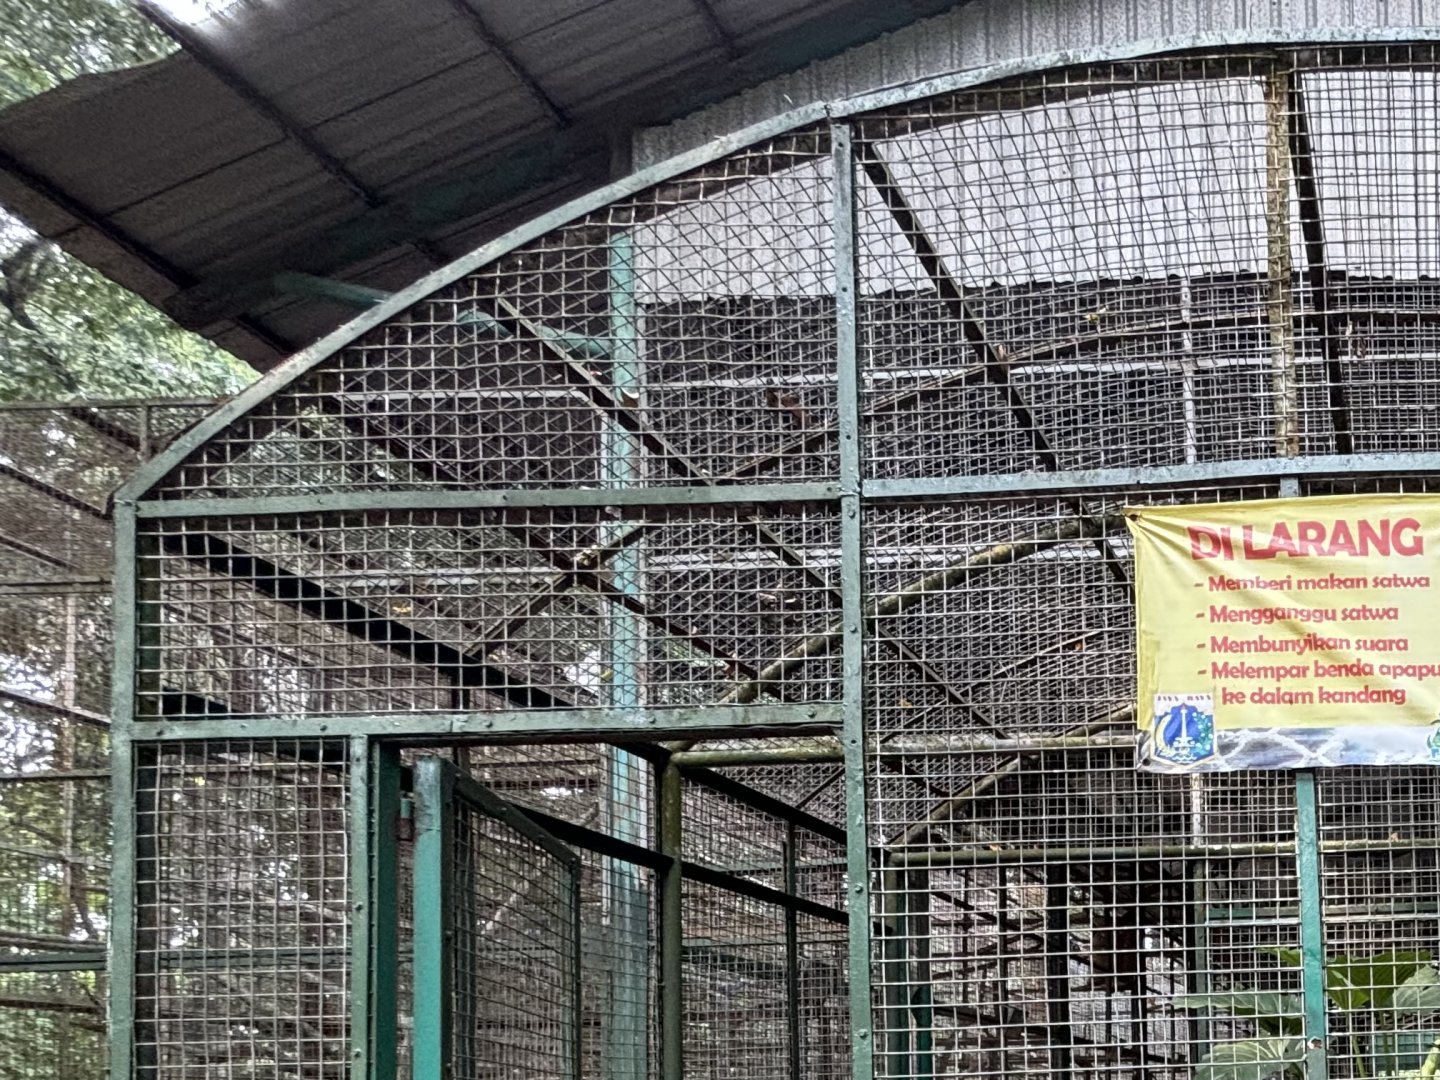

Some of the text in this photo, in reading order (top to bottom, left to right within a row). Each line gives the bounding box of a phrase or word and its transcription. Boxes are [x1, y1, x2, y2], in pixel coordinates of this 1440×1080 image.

[1187, 526, 1234, 561] DI
[1242, 517, 1424, 560] LARANG
[1208, 575, 1293, 592] Memberi
[1297, 573, 1368, 590] makan
[1372, 573, 1431, 589] satwa
[1209, 604, 1337, 625] Mengganggu
[1341, 604, 1399, 621] satwa
[1210, 632, 1351, 655] Membunyikan
[1355, 638, 1409, 651] suara
[1211, 661, 1309, 682] Melempar
[1314, 658, 1374, 678] benda
[1222, 687, 1246, 705] ke
[1250, 686, 1314, 705] dalam
[1318, 685, 1406, 705] kandang
